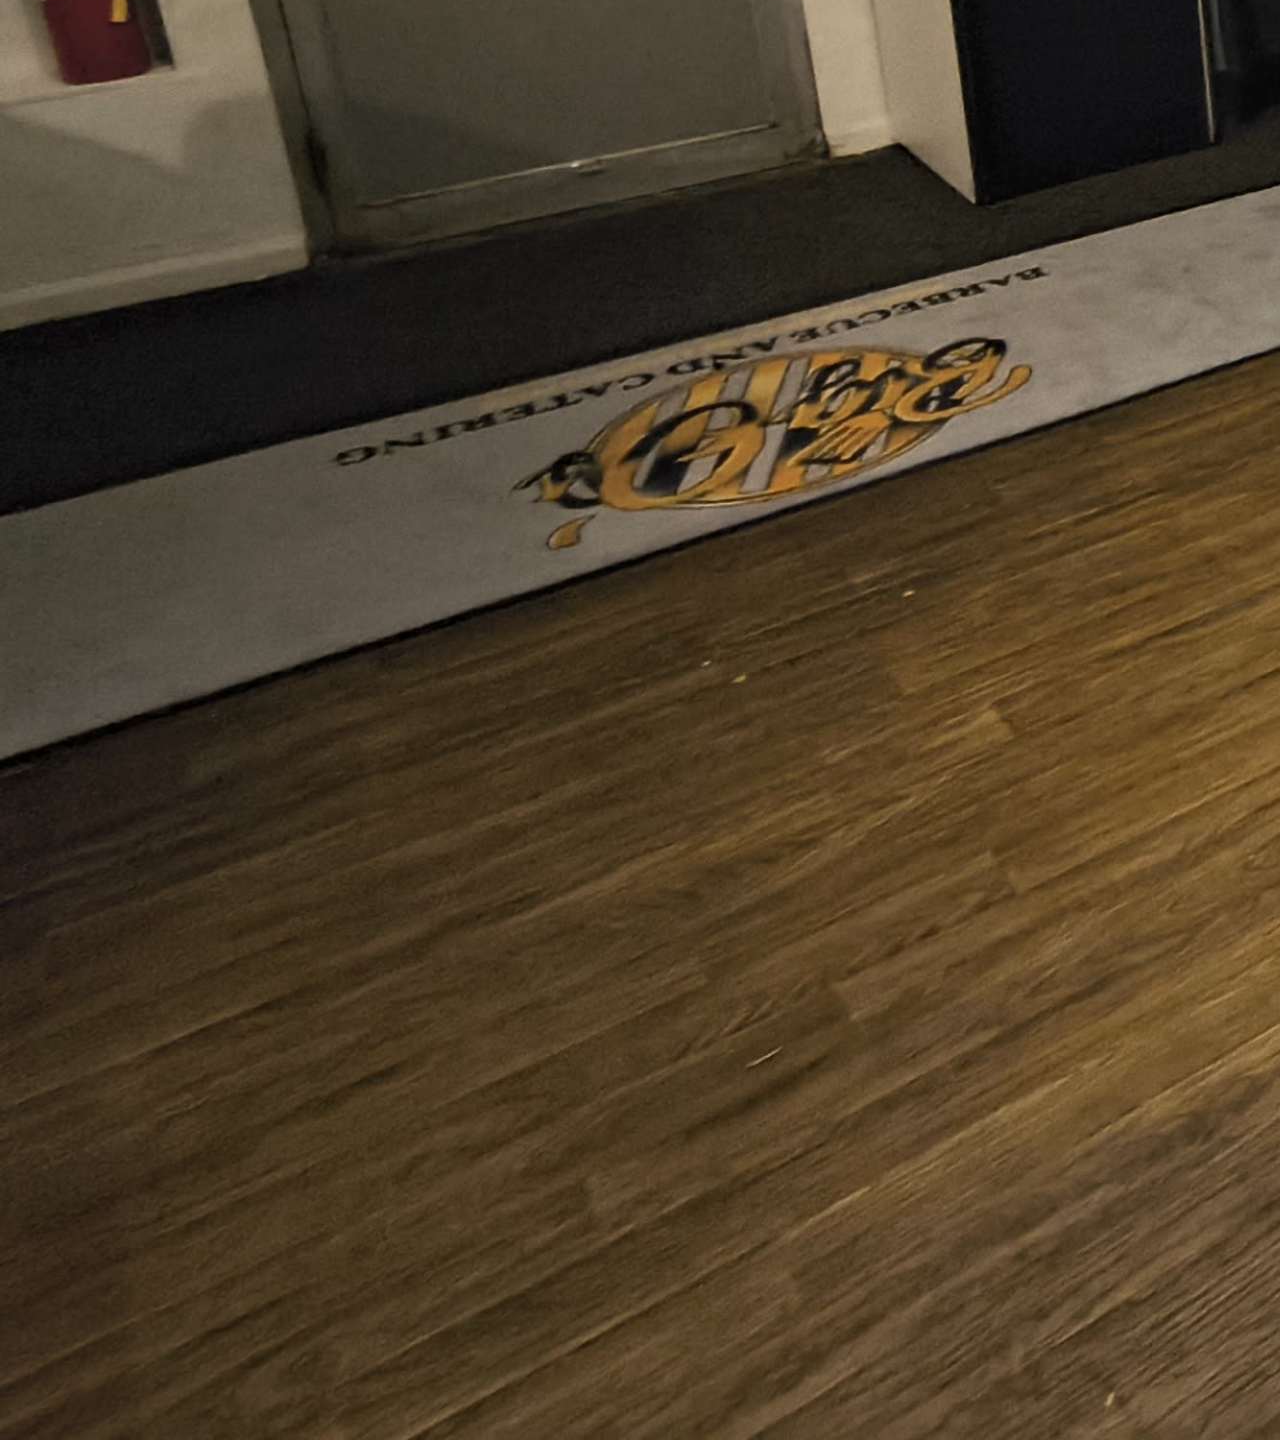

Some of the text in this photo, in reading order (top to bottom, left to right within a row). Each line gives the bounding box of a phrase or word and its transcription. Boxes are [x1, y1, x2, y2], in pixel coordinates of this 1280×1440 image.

[332, 265, 1049, 467] BARBECUE AND CATERING
